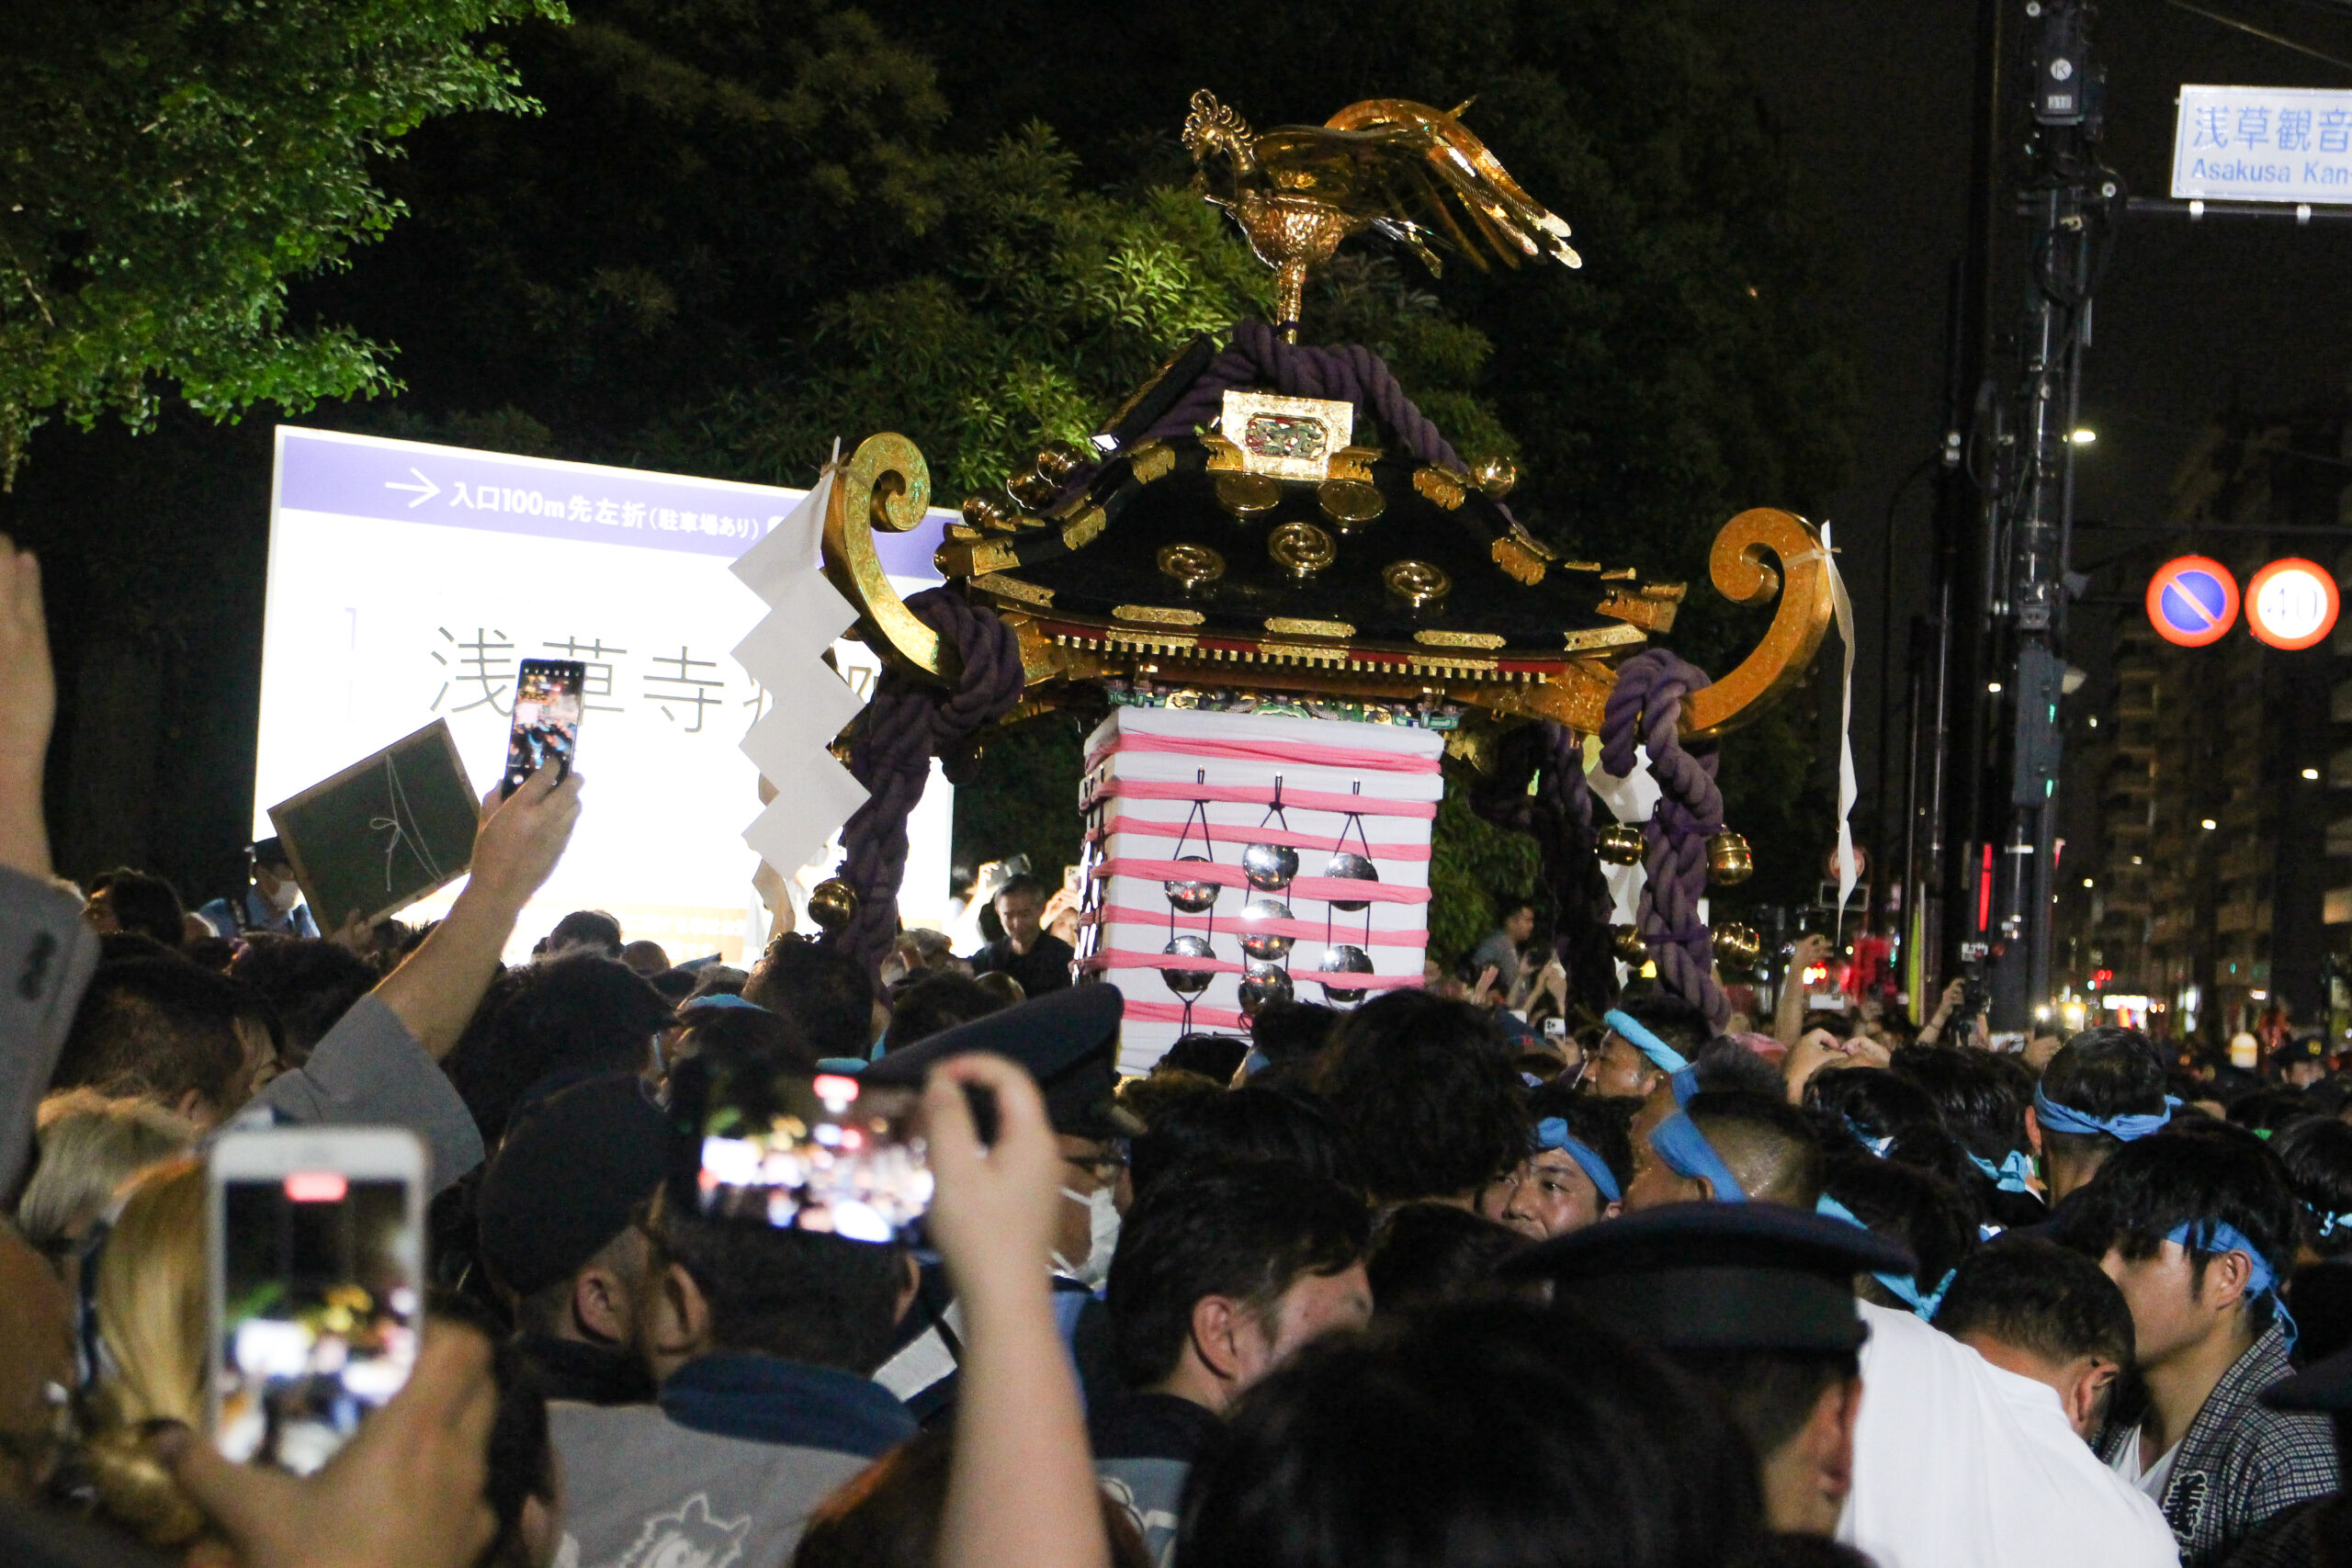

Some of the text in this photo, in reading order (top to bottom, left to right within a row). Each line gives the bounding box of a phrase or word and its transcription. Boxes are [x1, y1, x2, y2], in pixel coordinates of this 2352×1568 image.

[2193, 106, 2352, 152] 浅草観音
[2191, 158, 2352, 185] Asakusa Kan
[429, 626, 880, 735] 浅草寺
